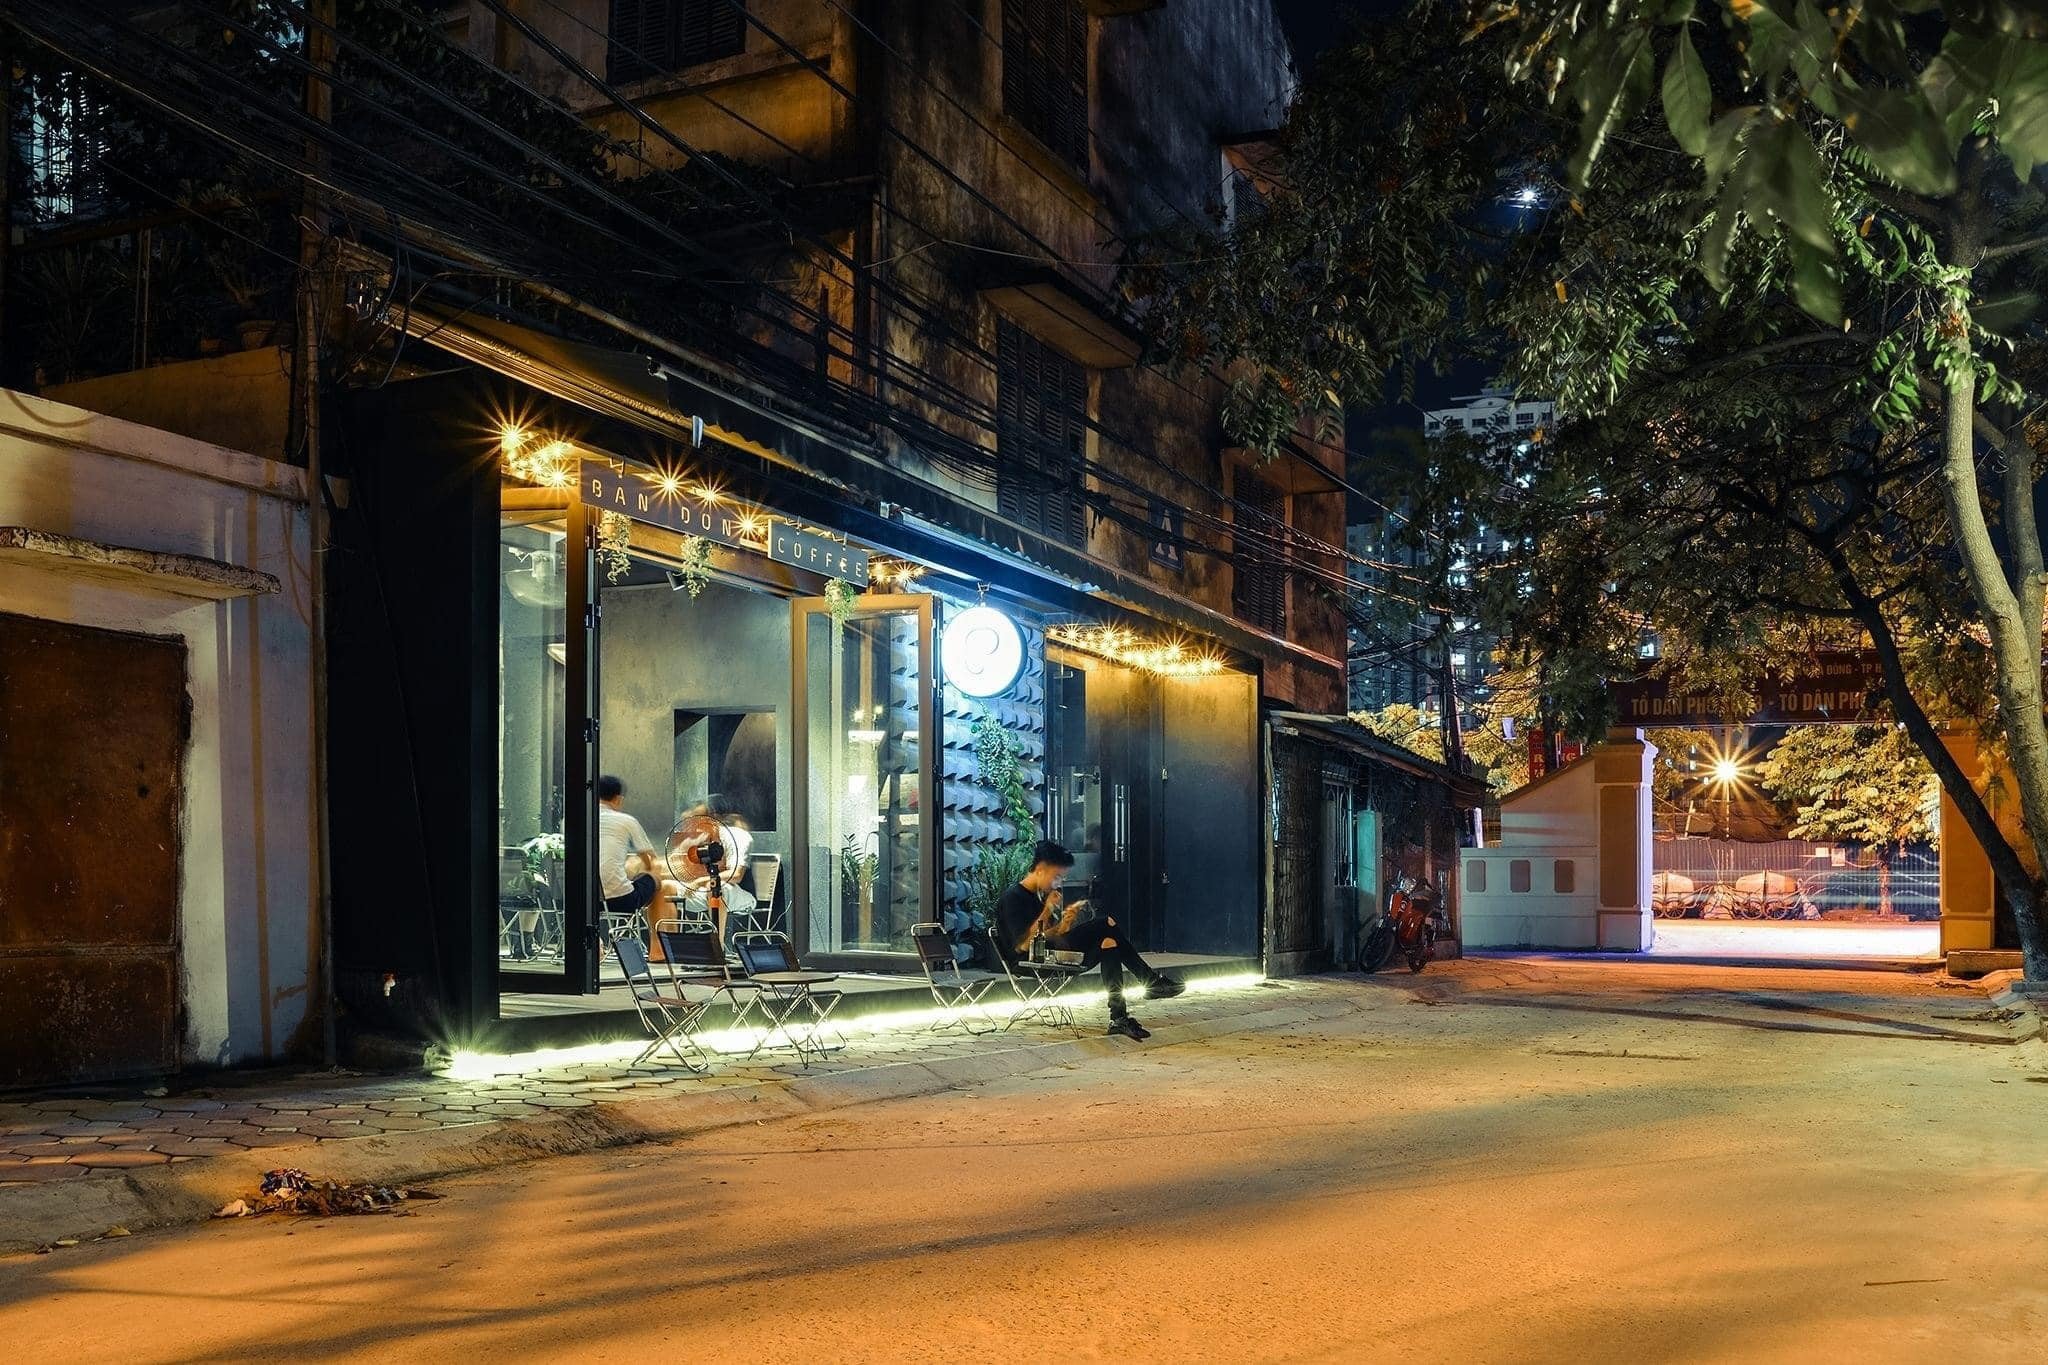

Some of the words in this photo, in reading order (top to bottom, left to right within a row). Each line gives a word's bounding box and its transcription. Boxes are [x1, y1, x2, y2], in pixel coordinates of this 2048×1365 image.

[592, 478, 648, 512] BAN
[681, 506, 731, 537] DON
[777, 536, 863, 578] COFFEE
